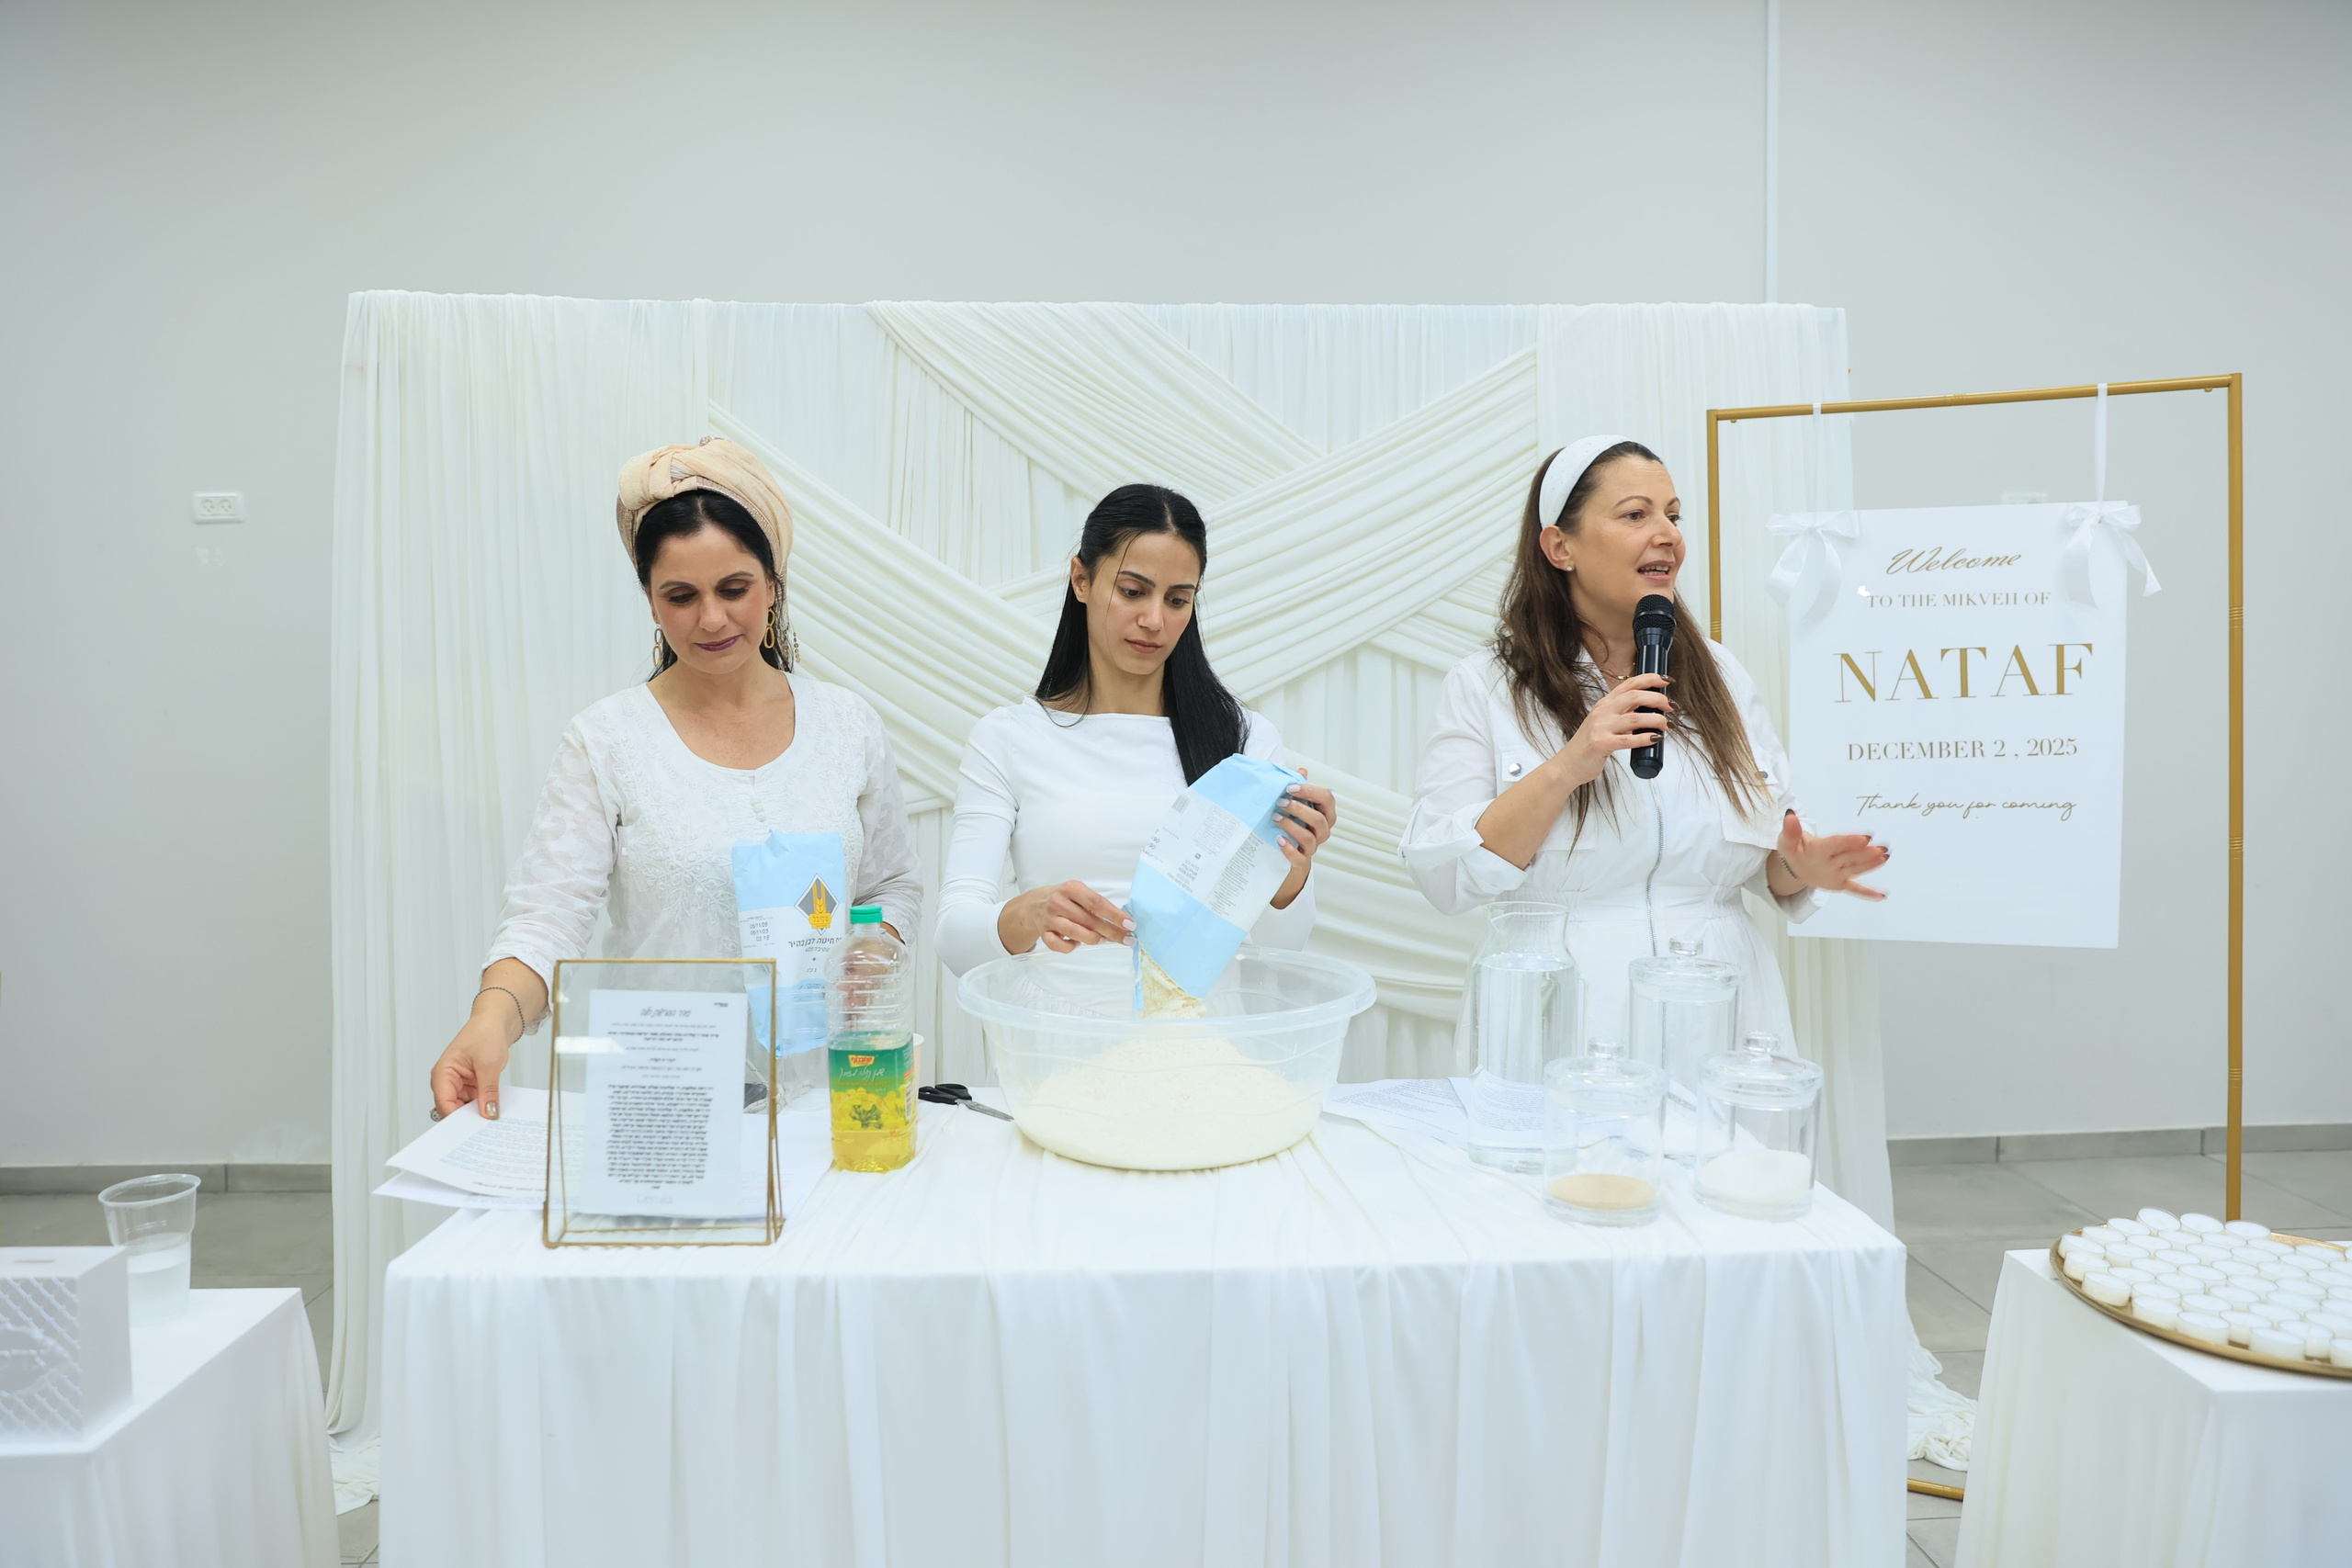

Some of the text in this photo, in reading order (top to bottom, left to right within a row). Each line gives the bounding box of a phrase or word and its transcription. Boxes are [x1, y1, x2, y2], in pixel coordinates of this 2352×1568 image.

[1886, 547, 2021, 574] Welcome
[1867, 592, 2051, 607] TO THE MIKVEH OF
[1834, 643, 2093, 703] NATAF
[1849, 741, 1984, 761] DECEMBER
[1994, 739, 2006, 758] 2
[2027, 738, 2077, 757] 2025
[1856, 793, 2076, 821] Thank you for coming
[817, 937, 835, 945] חיטה
